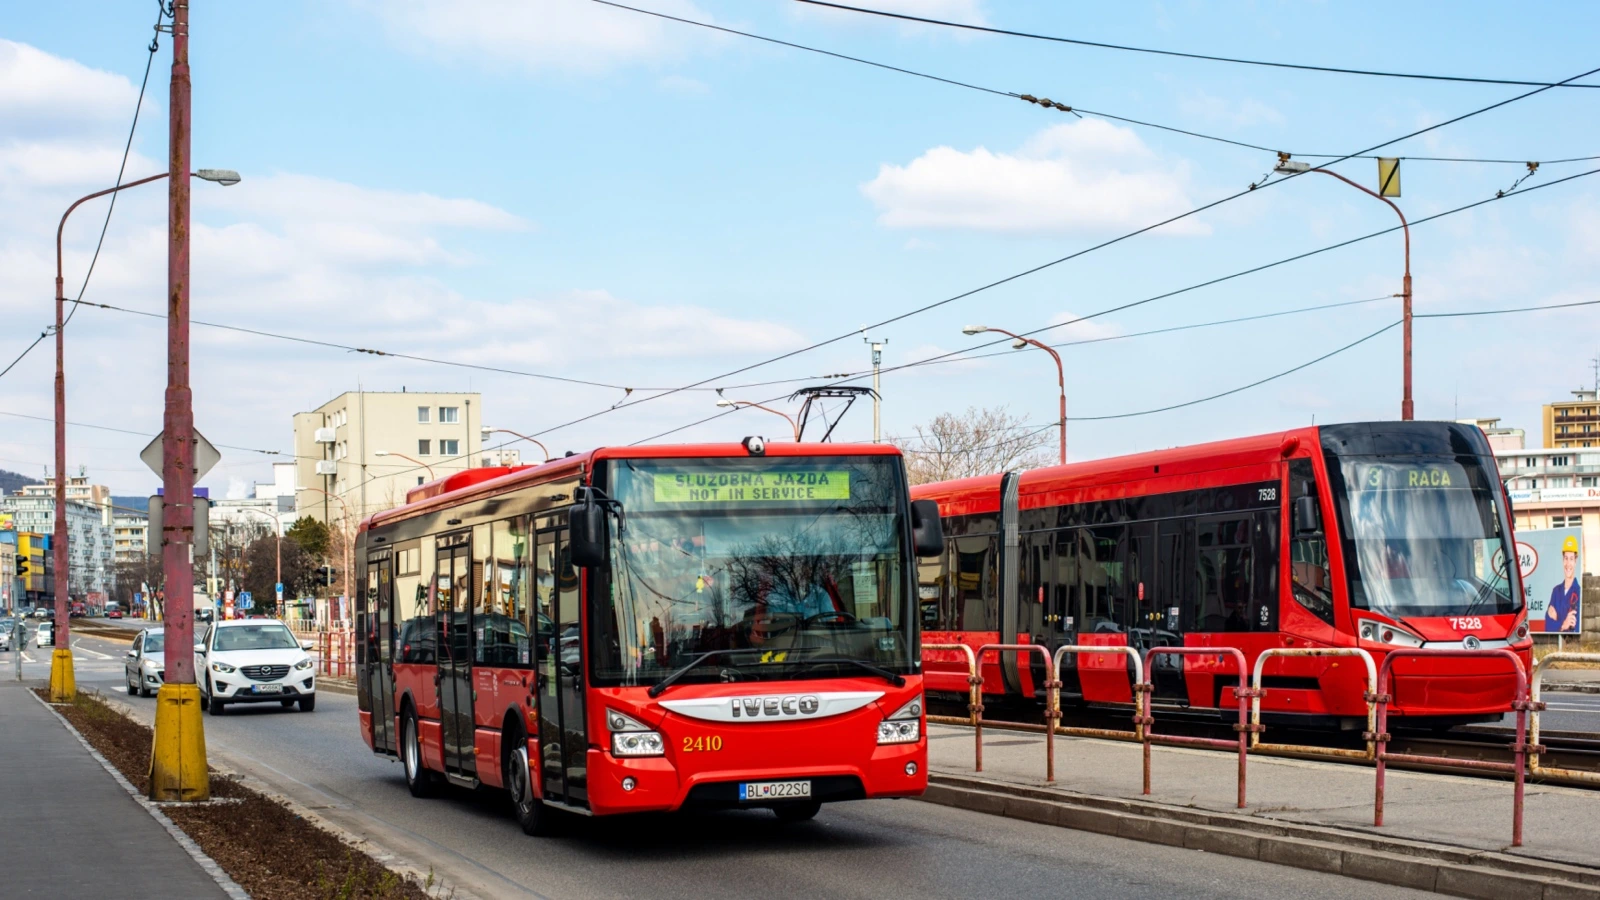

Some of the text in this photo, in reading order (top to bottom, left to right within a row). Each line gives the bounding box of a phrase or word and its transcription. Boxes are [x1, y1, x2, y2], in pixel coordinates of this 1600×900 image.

[773, 472, 829, 486] JAZDA
[1369, 467, 1380, 487] 3
[690, 487, 814, 500] NOT IN SERVICE
[1258, 488, 1276, 501] 7528
[1449, 617, 1482, 630] 7528
[732, 695, 819, 717] IVECO
[683, 735, 722, 752] 2410
